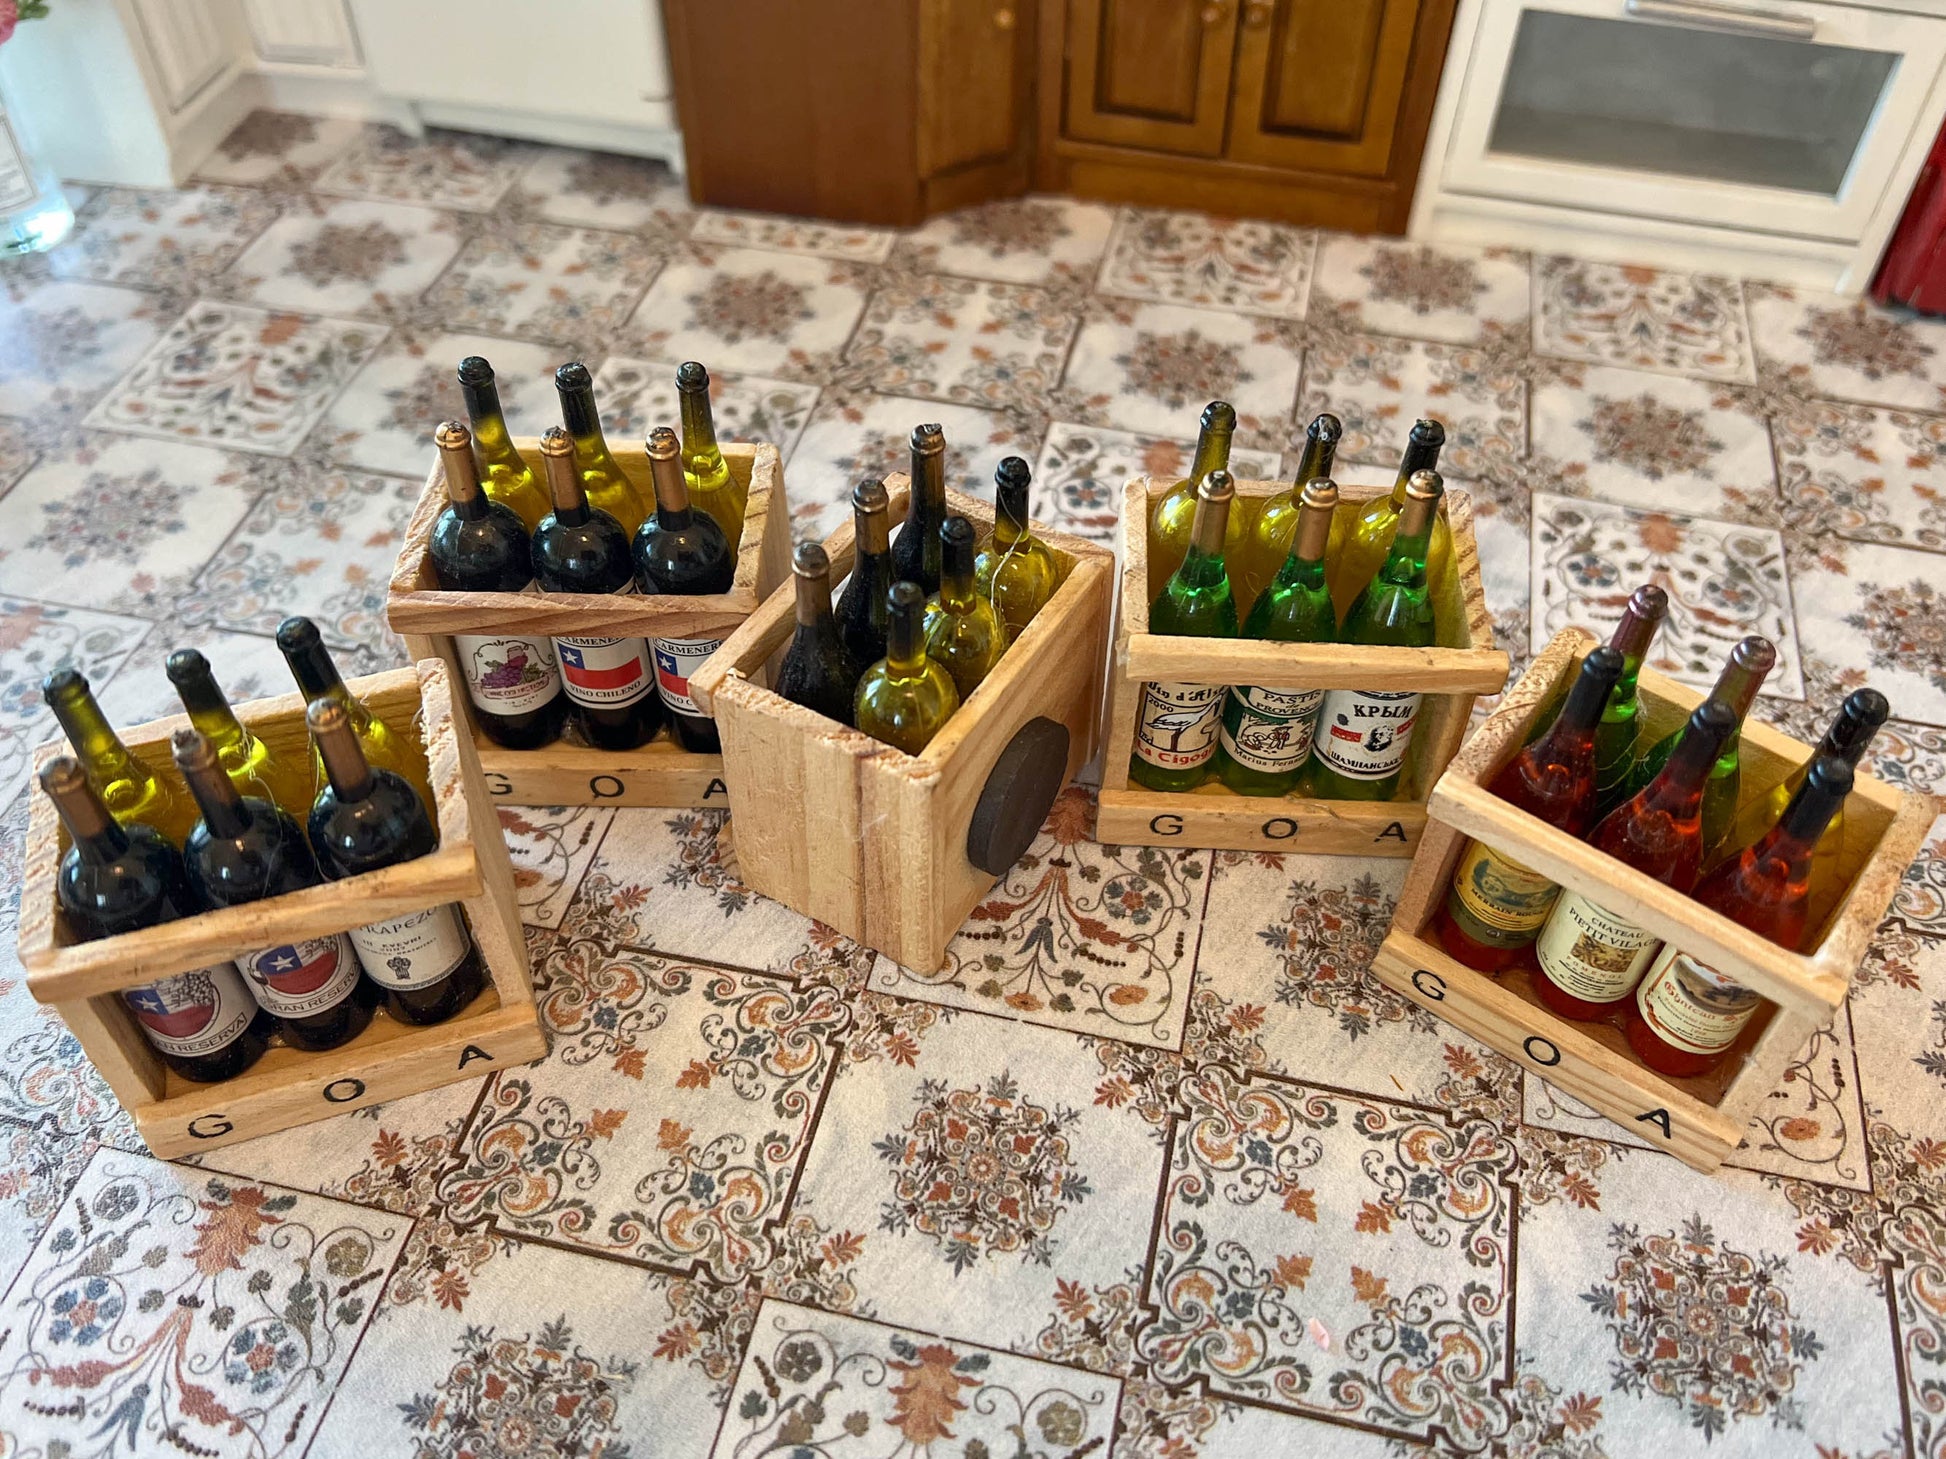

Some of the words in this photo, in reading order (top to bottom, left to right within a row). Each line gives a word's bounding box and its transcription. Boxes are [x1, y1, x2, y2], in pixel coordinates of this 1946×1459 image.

[570, 684, 594, 698] VINO
[595, 680, 641, 698] CHILENO
[662, 689, 684, 705] VINO
[1263, 692, 1321, 704] PASTIS
[1148, 697, 1174, 713] 2000
[1353, 704, 1413, 718] КРЫМ
[1234, 748, 1267, 766] Marius
[1591, 917, 1644, 938] CHATEAU
[308, 961, 360, 1009] RESERV
[178, 1018, 245, 1051] RESERVA
